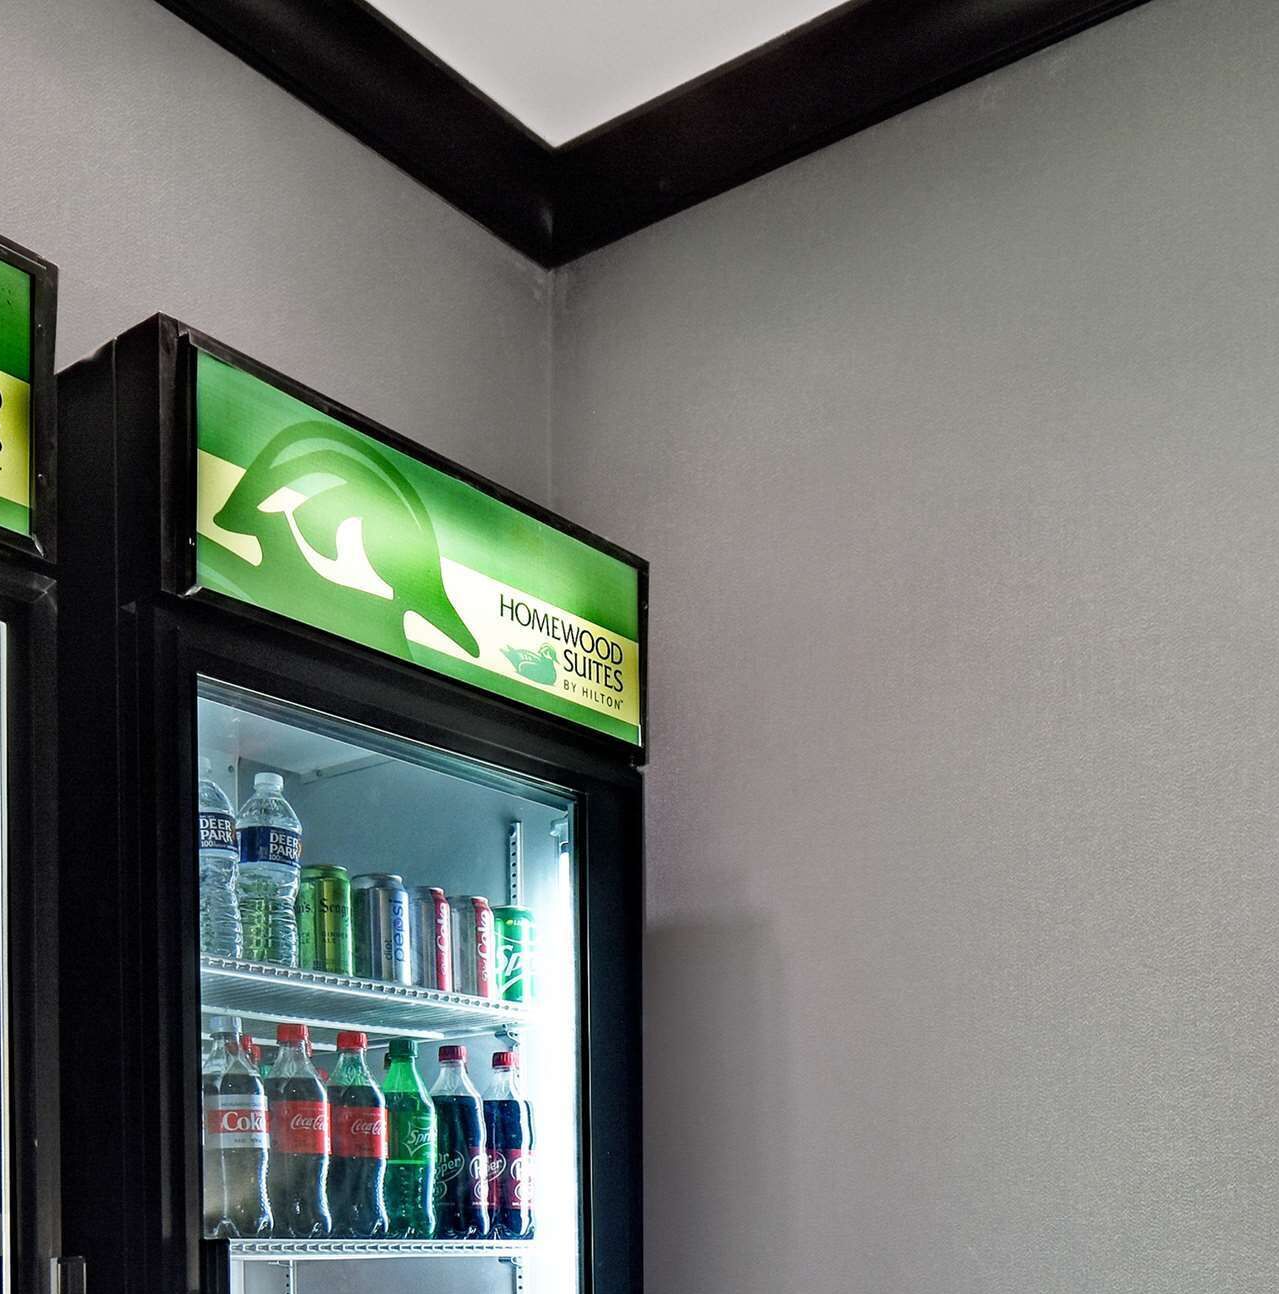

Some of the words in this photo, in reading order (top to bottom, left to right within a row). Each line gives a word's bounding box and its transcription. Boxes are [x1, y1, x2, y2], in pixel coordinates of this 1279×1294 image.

[499, 593, 624, 665] HOMEWOOD
[563, 649, 624, 692] SUITES
[563, 679, 577, 693] BY
[582, 687, 621, 710] HILTON
[199, 818, 232, 831] DEER
[200, 830, 233, 845] PARK
[270, 833, 299, 848] DEER
[270, 844, 298, 860] PARK
[391, 899, 404, 962] pepsi
[436, 902, 449, 952] Coke
[477, 908, 491, 961] Coke
